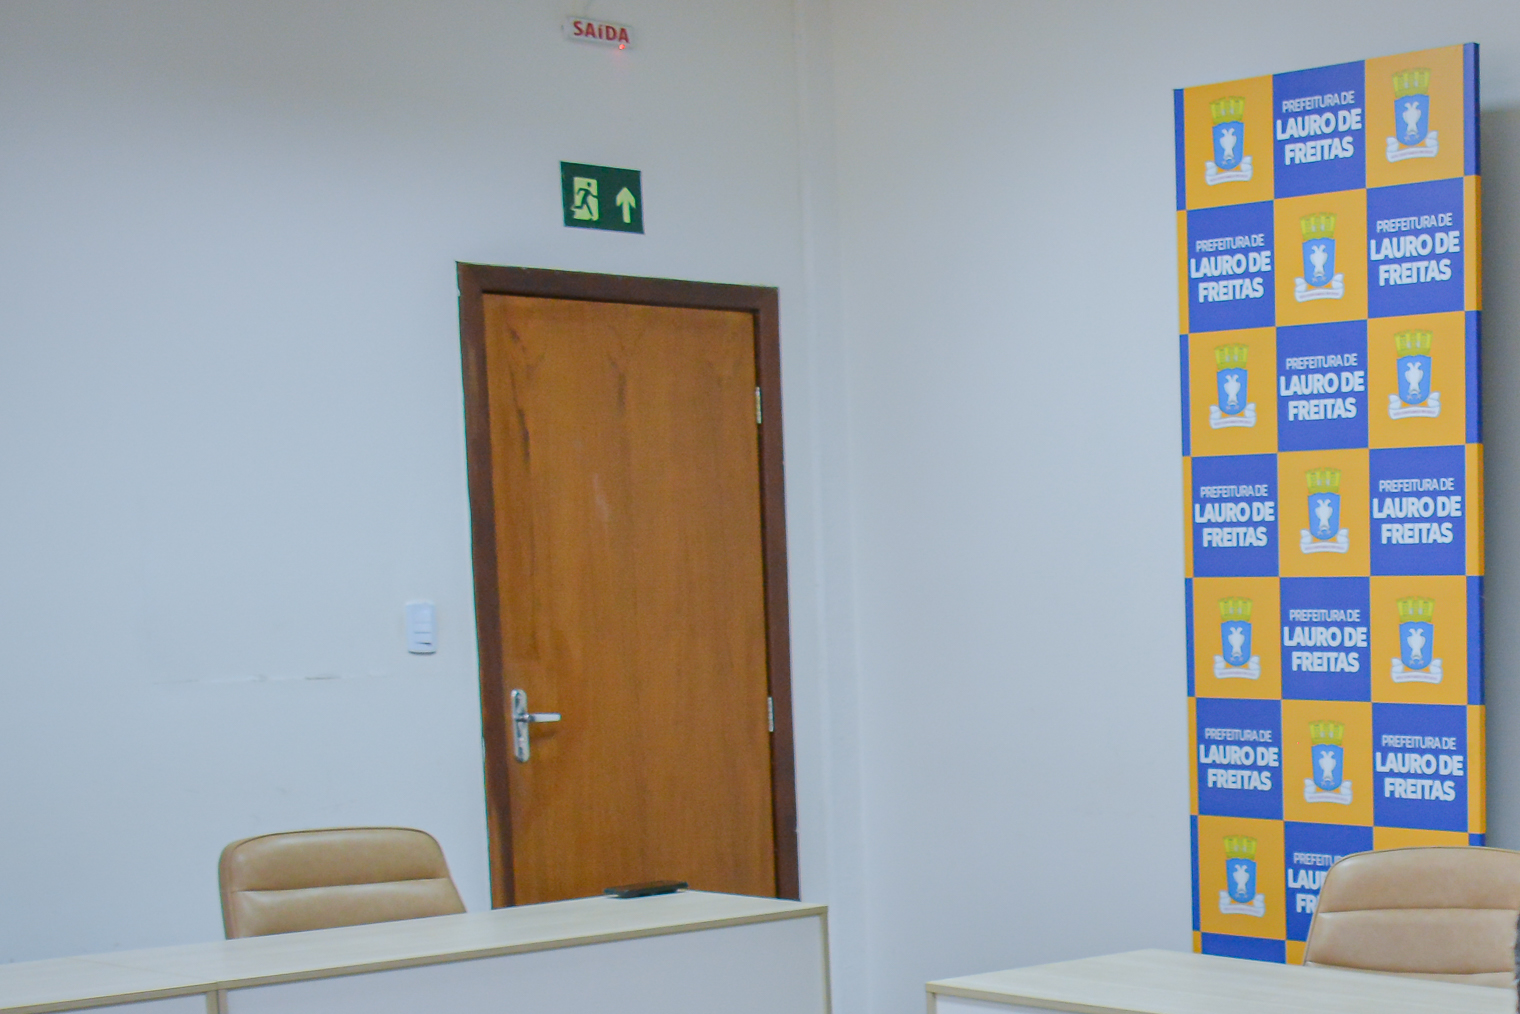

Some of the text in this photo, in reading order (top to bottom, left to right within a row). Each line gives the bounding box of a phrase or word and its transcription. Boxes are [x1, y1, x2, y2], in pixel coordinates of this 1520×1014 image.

[1282, 90, 1355, 113] PREFEITURA DE
[1276, 107, 1362, 140] LAURO DE
[1285, 135, 1354, 165] FREITAS
[1377, 212, 1453, 233] PREFEITURA DE
[1196, 233, 1265, 252] PREFEITURA DE
[1370, 230, 1460, 260] LAURO DE
[1190, 250, 1271, 278] LAURO DE
[1379, 258, 1452, 286] FREITAS
[1198, 277, 1264, 303] FREITAS
[1286, 353, 1358, 370] PREFEITURA DE
[1280, 370, 1365, 396] LAURO DE
[1288, 397, 1357, 421] FREITAS
[1200, 484, 1268, 498] PREFEITURA DE
[1379, 477, 1454, 492] PREFEITURA DE
[1195, 501, 1275, 523] LAURO DE
[1373, 496, 1462, 518] LAURO DE
[1203, 526, 1268, 547] FREITAS
[1381, 522, 1453, 544] FREITAS
[1290, 609, 1360, 622] PREFEITURA DE
[1284, 626, 1367, 647] LAURO DE
[1292, 651, 1360, 672] FREITAS
[1205, 728, 1272, 742] PREFEITURA DE
[1382, 735, 1457, 750] PREFEITURA DE
[1199, 744, 1279, 767] LAURO DE
[1376, 752, 1464, 776] LAURO DE
[1207, 768, 1272, 791] FREITAS
[1384, 777, 1456, 801] FREITAS
[1287, 868, 1328, 890] LAU
